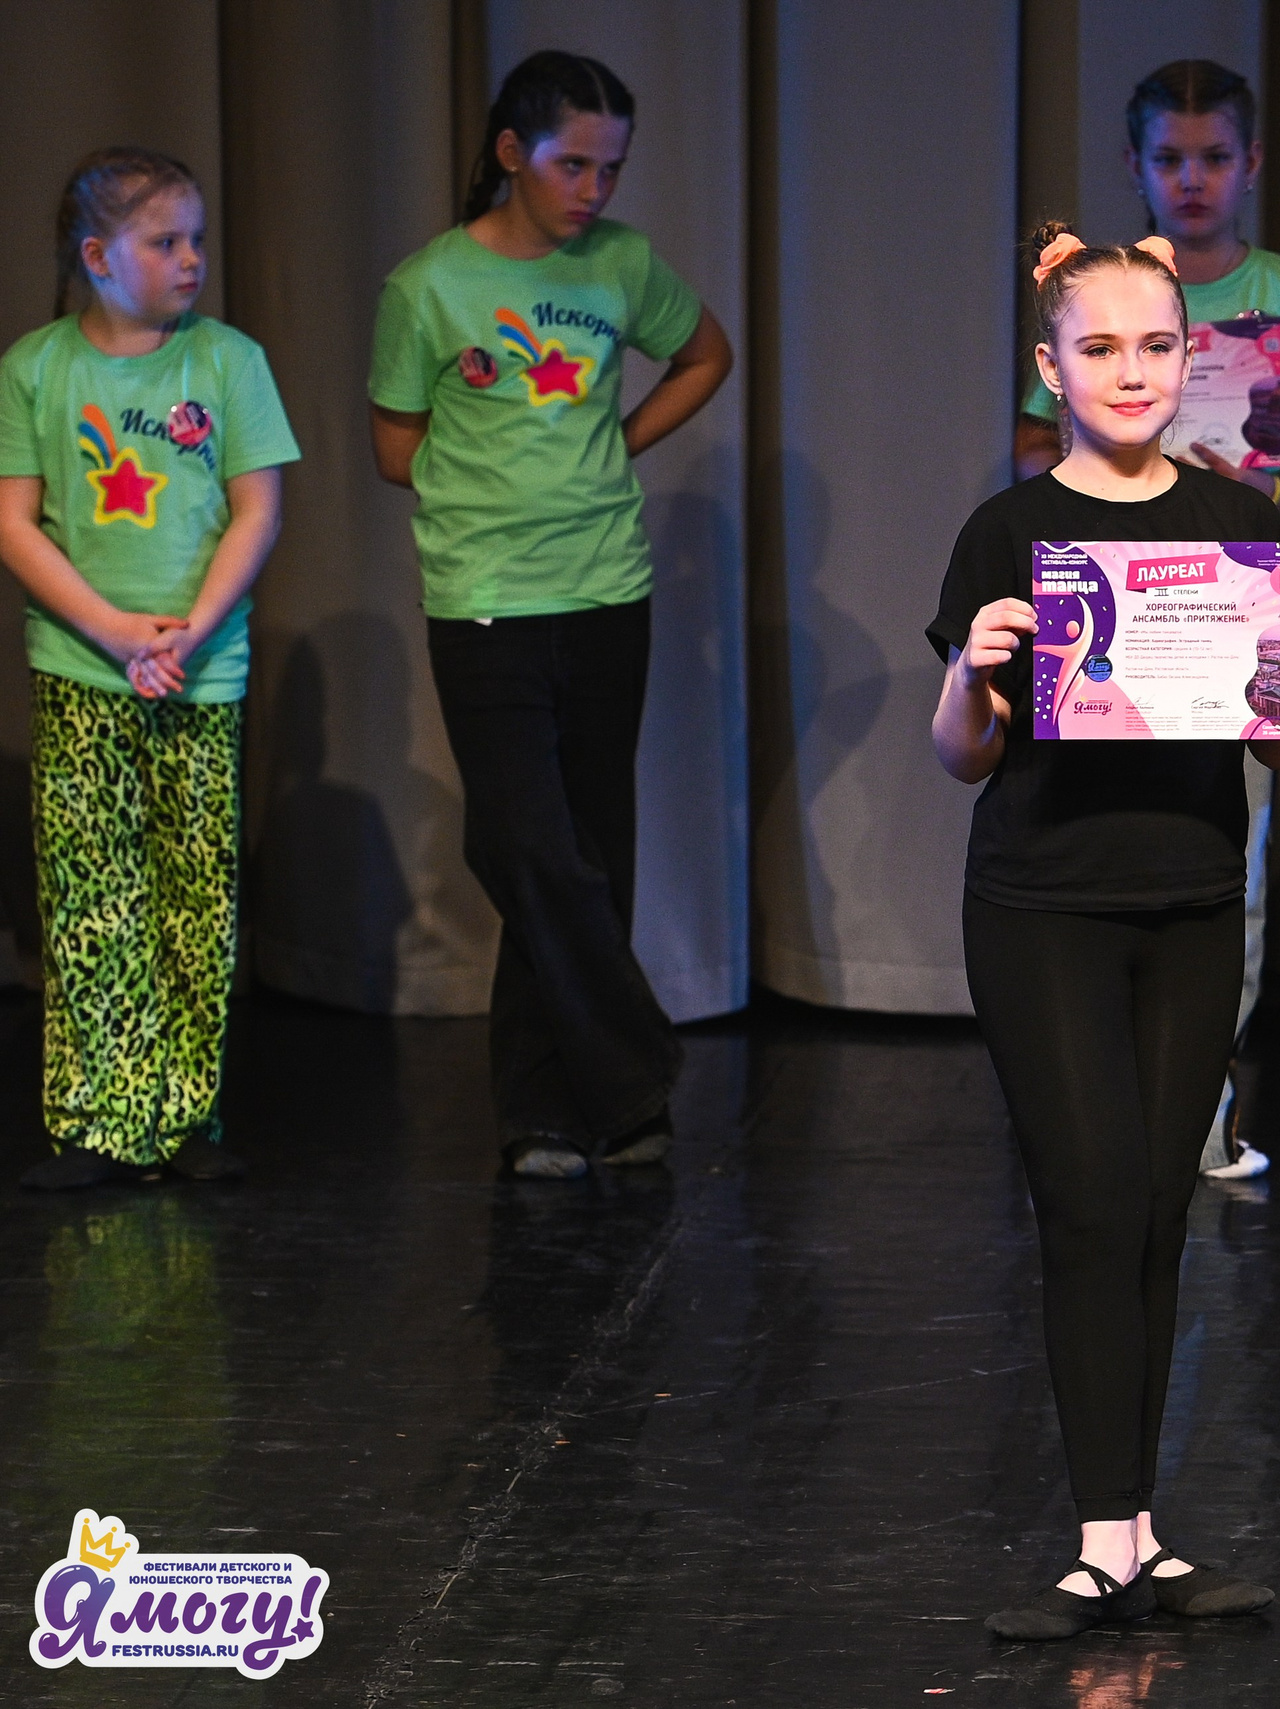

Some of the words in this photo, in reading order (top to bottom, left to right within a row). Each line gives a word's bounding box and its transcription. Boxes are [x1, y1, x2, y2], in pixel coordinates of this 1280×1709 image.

[1136, 562, 1206, 583] ЛАУРЕАТ
[1146, 602, 1236, 612] ХОРЕОГРАФИЧЕСКИЙ
[1132, 614, 1180, 623] АНСАМБЛЬ
[1184, 614, 1250, 623] «ПРИТЯЖЕНИЕ»
[1074, 700, 1084, 714] Я
[1084, 702, 1112, 716] могу!
